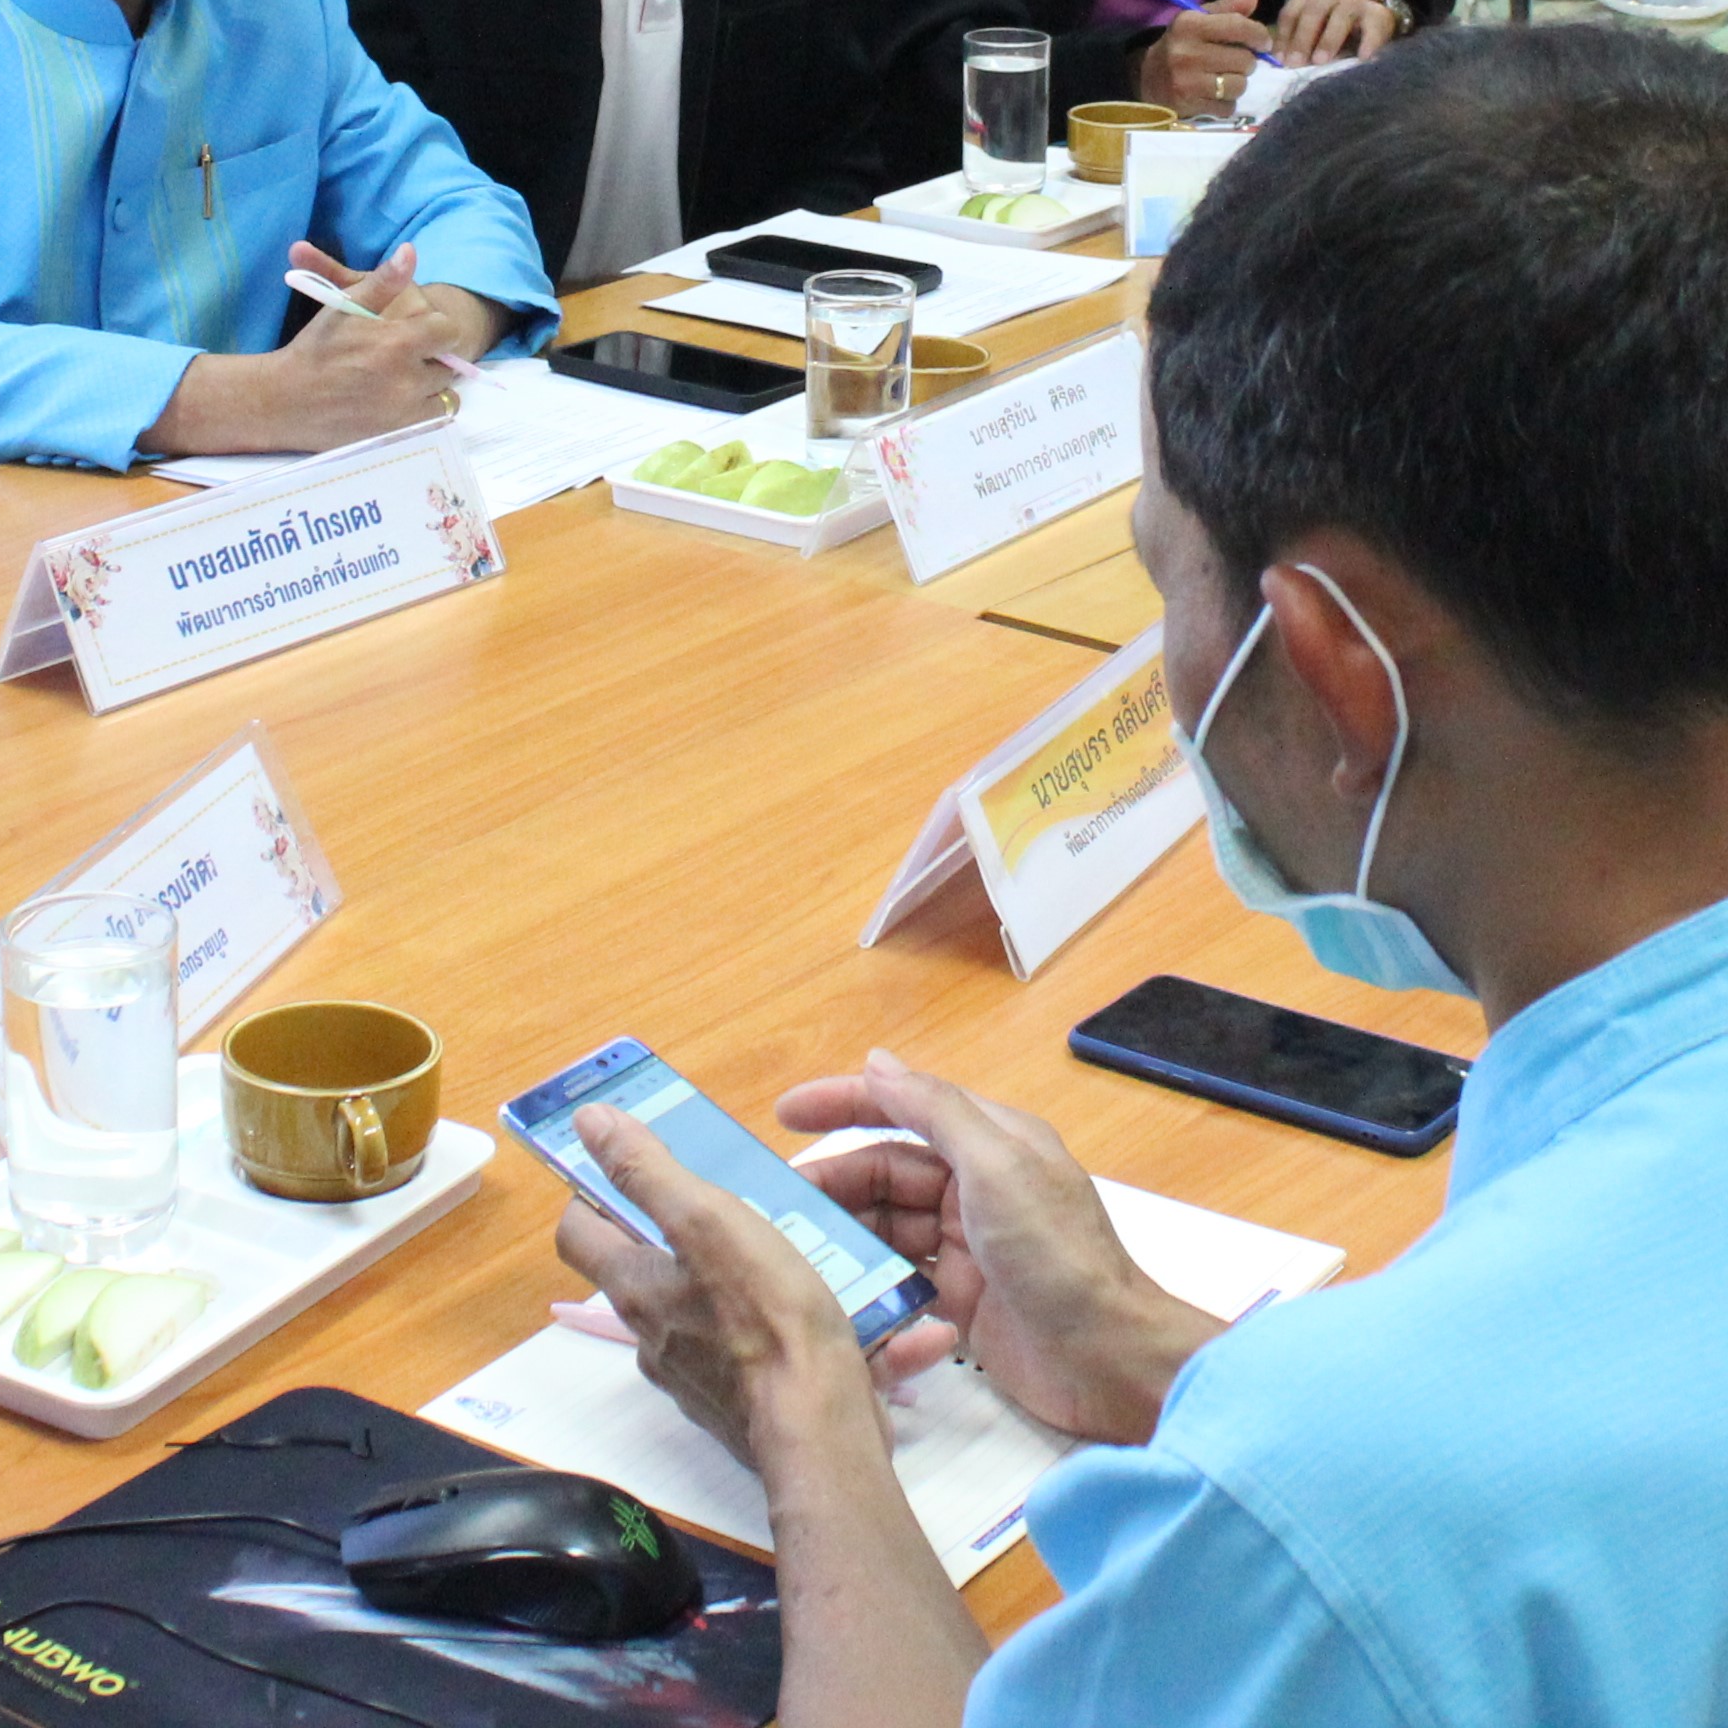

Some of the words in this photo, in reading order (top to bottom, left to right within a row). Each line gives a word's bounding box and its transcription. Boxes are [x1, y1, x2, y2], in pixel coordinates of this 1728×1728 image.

[166, 508, 301, 591] นายสมศักดิ์
[298, 498, 383, 545] ไกรเดช
[176, 544, 401, 639] พัฒนาการอำเภอคำเขื่อนแก้ว
